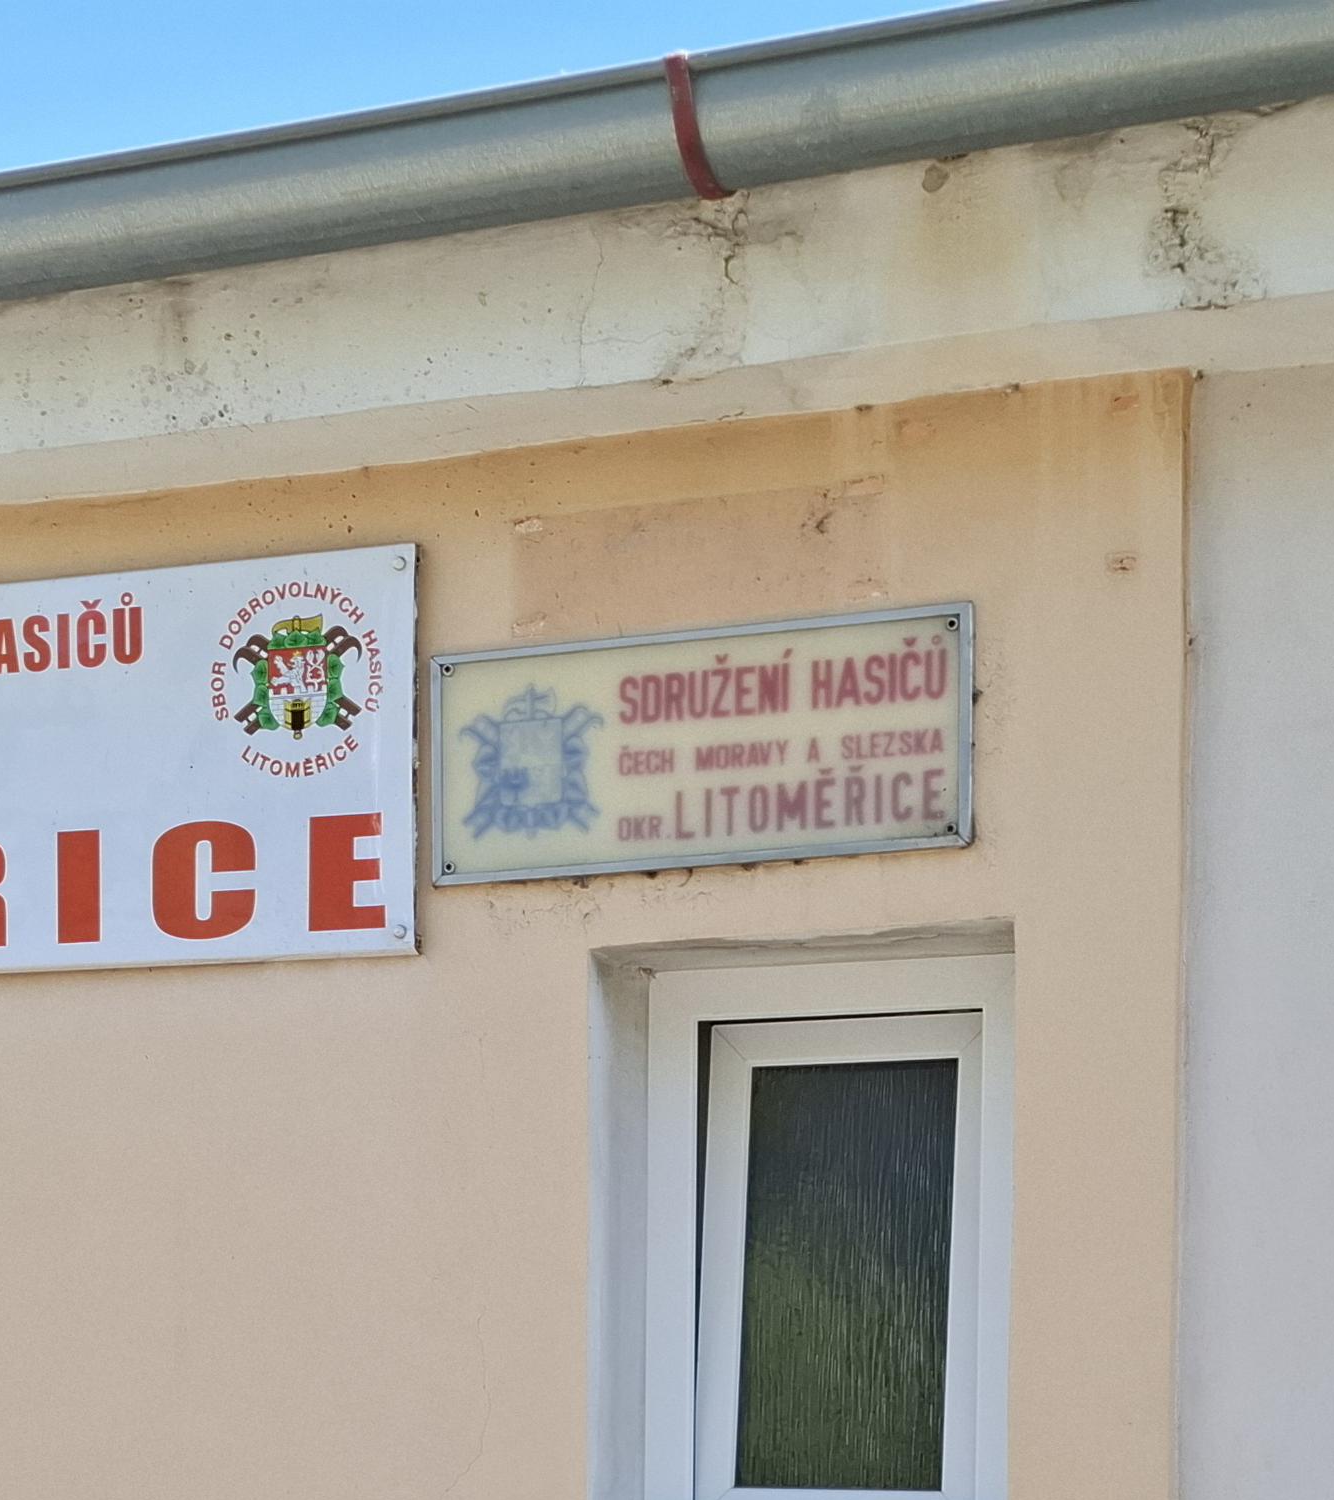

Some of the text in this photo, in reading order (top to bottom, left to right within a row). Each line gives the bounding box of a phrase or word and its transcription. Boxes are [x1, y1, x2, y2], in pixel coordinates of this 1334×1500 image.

[219, 581, 364, 650] DOBROVOLNÝCH
[210, 661, 229, 721] SBOR
[619, 635, 947, 725] SDRUŽENÍ HASIČŮ
[241, 734, 359, 778] LITOMĚŘICE
[618, 728, 944, 776] ČECH MORAVY A SLEZSKA
[675, 765, 946, 840] LITOMĚŘICE
